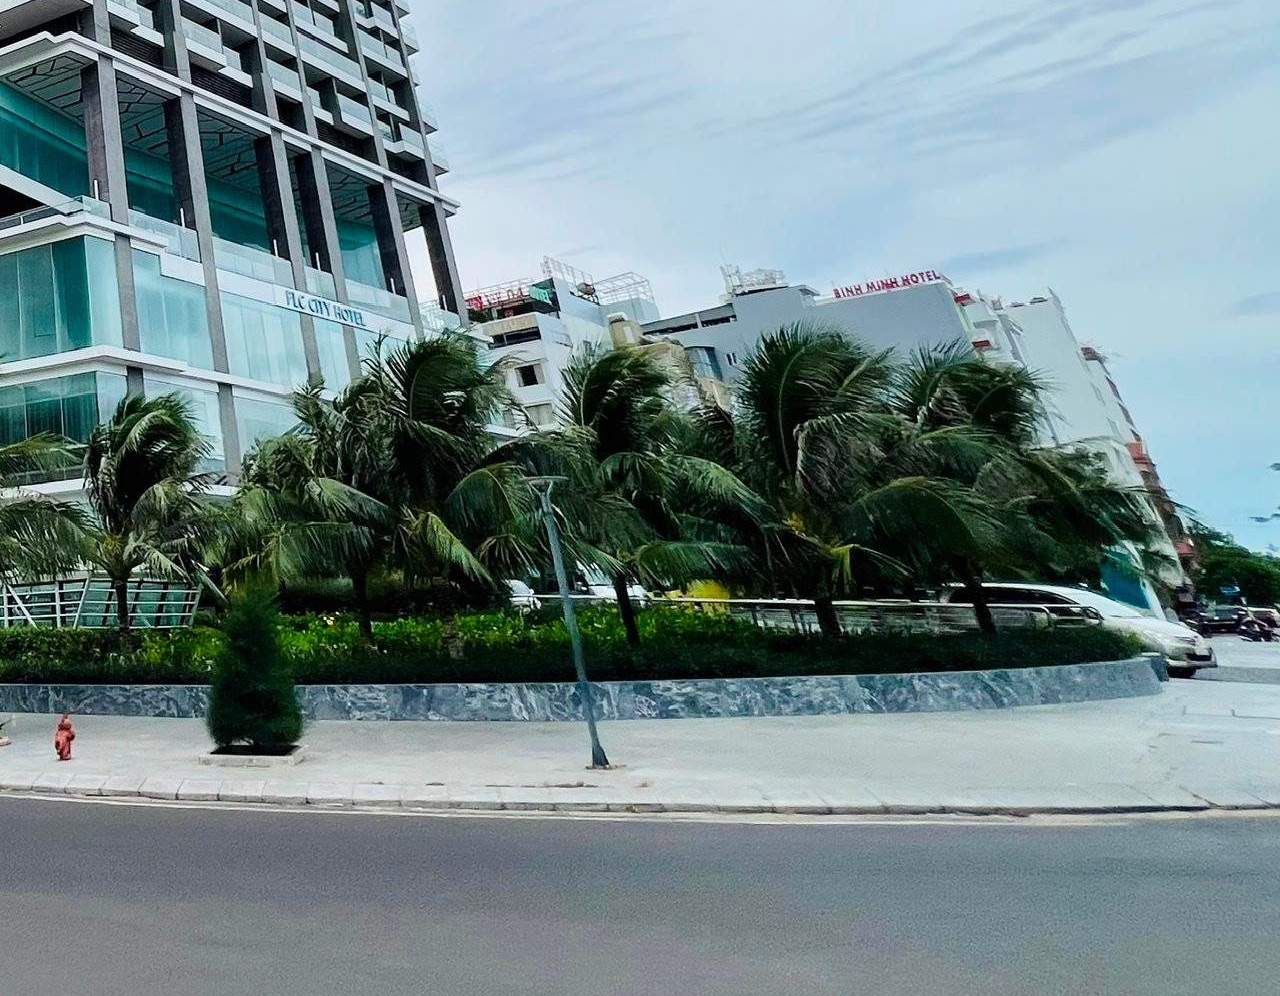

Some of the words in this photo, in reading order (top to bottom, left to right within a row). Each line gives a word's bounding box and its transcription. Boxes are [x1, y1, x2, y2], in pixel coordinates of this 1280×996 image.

[866, 277, 900, 294] MINH
[901, 269, 941, 287] HOTEL
[308, 298, 331, 317] CITY
[332, 304, 367, 327] HOTEL
